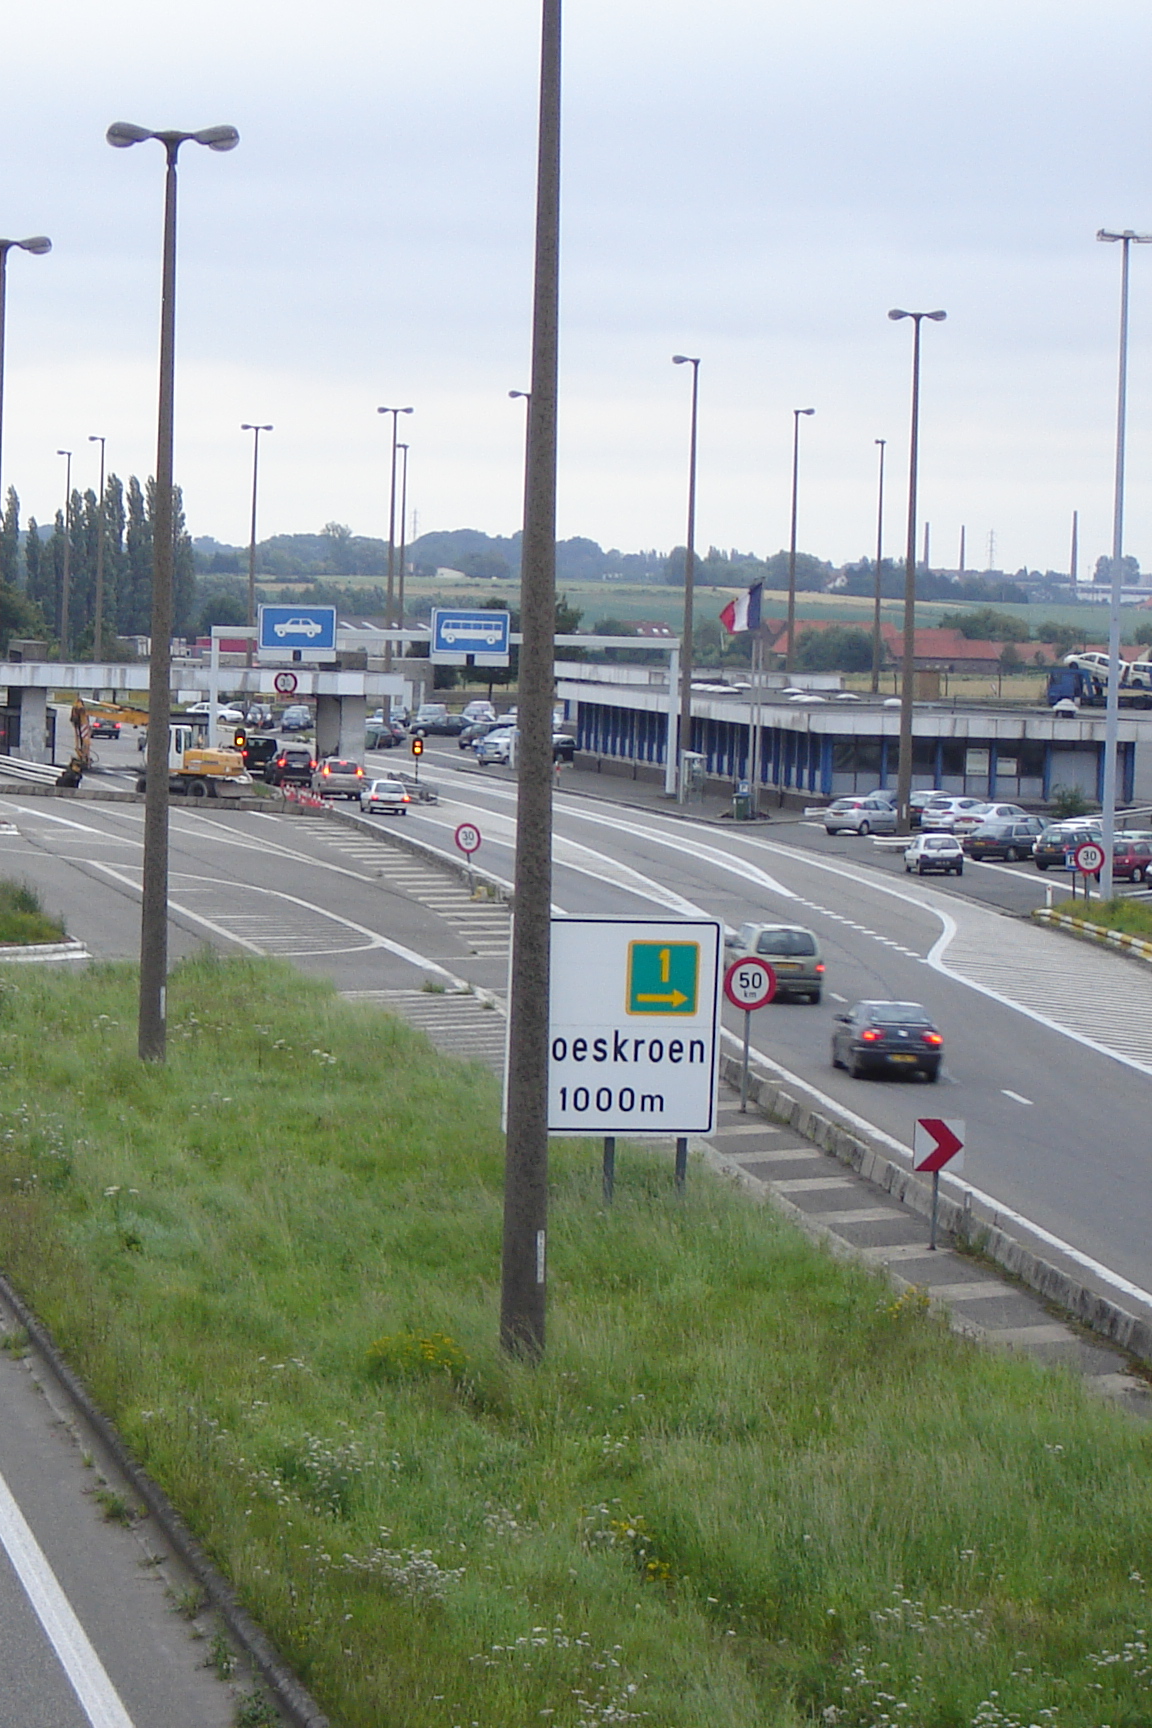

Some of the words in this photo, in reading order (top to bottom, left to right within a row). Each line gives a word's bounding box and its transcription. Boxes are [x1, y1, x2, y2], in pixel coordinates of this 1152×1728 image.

[461, 830, 475, 841] 30
[1082, 850, 1097, 861] 30
[659, 949, 670, 982] 1
[739, 972, 762, 988] 50
[743, 989, 757, 999] km
[552, 1030, 704, 1062] oeskroen
[560, 1087, 664, 1112] 1000m
